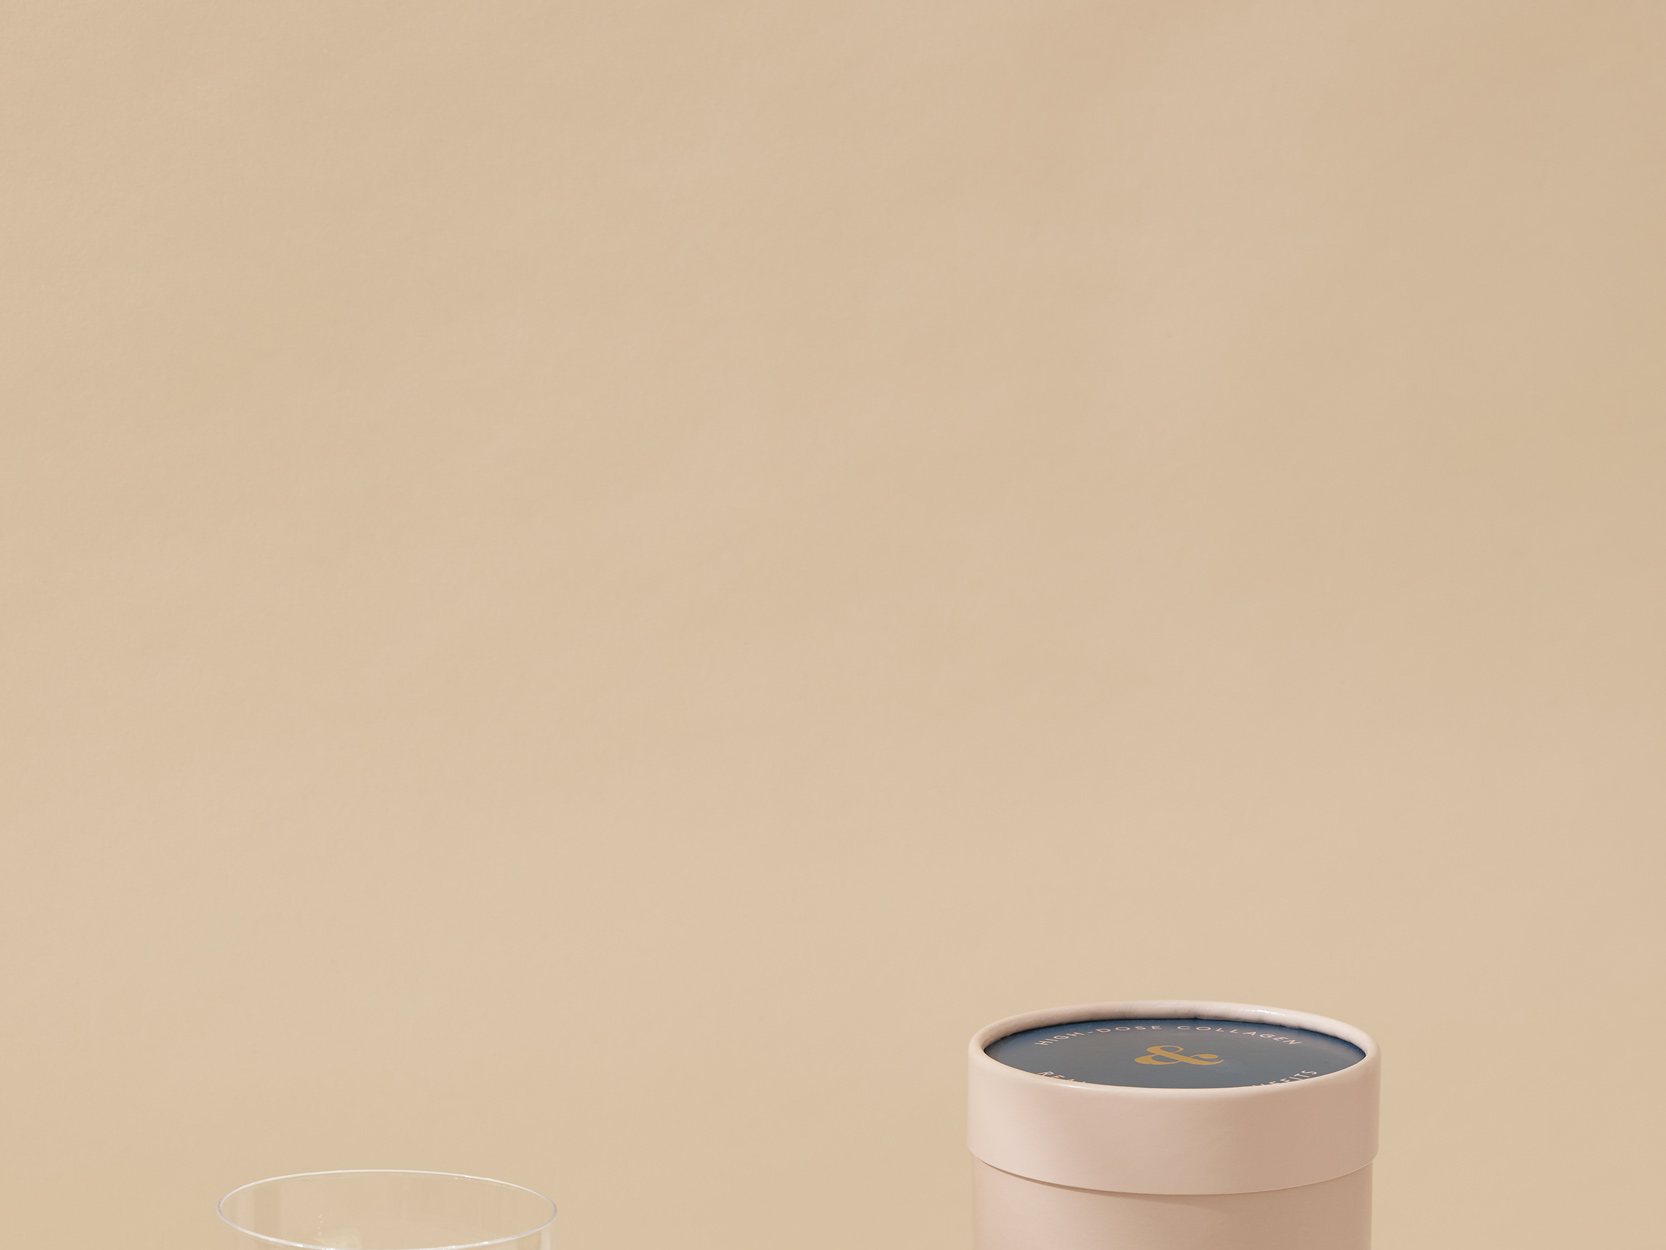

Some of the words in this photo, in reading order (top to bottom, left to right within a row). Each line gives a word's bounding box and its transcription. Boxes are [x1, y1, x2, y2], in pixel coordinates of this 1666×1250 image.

[1034, 1025, 1163, 1046] HIGH-DOSE
[1176, 1025, 1302, 1046] COLLAGEN
[1134, 1045, 1224, 1066] &
